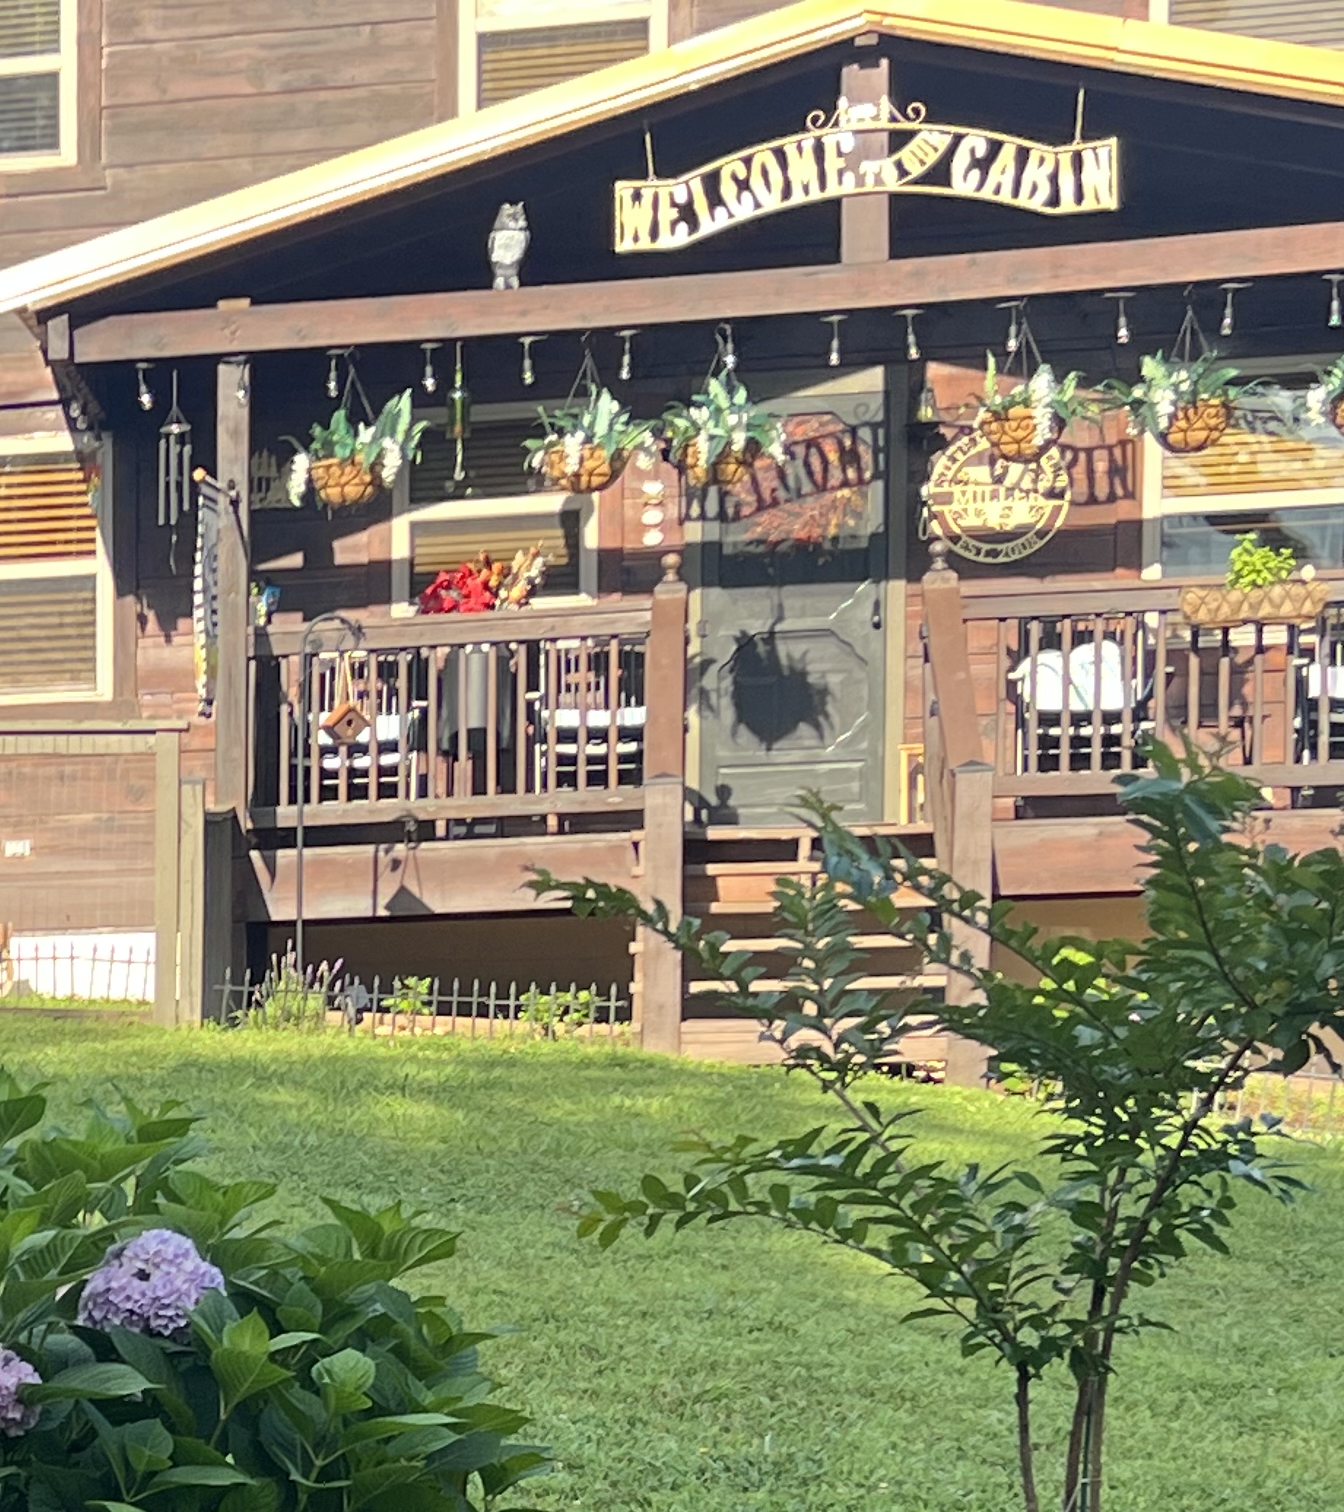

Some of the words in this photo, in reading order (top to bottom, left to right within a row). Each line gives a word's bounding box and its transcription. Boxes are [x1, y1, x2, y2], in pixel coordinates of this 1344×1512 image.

[619, 132, 855, 248] WELCOME
[859, 158, 899, 188] TO
[950, 134, 1112, 212] CABIN
